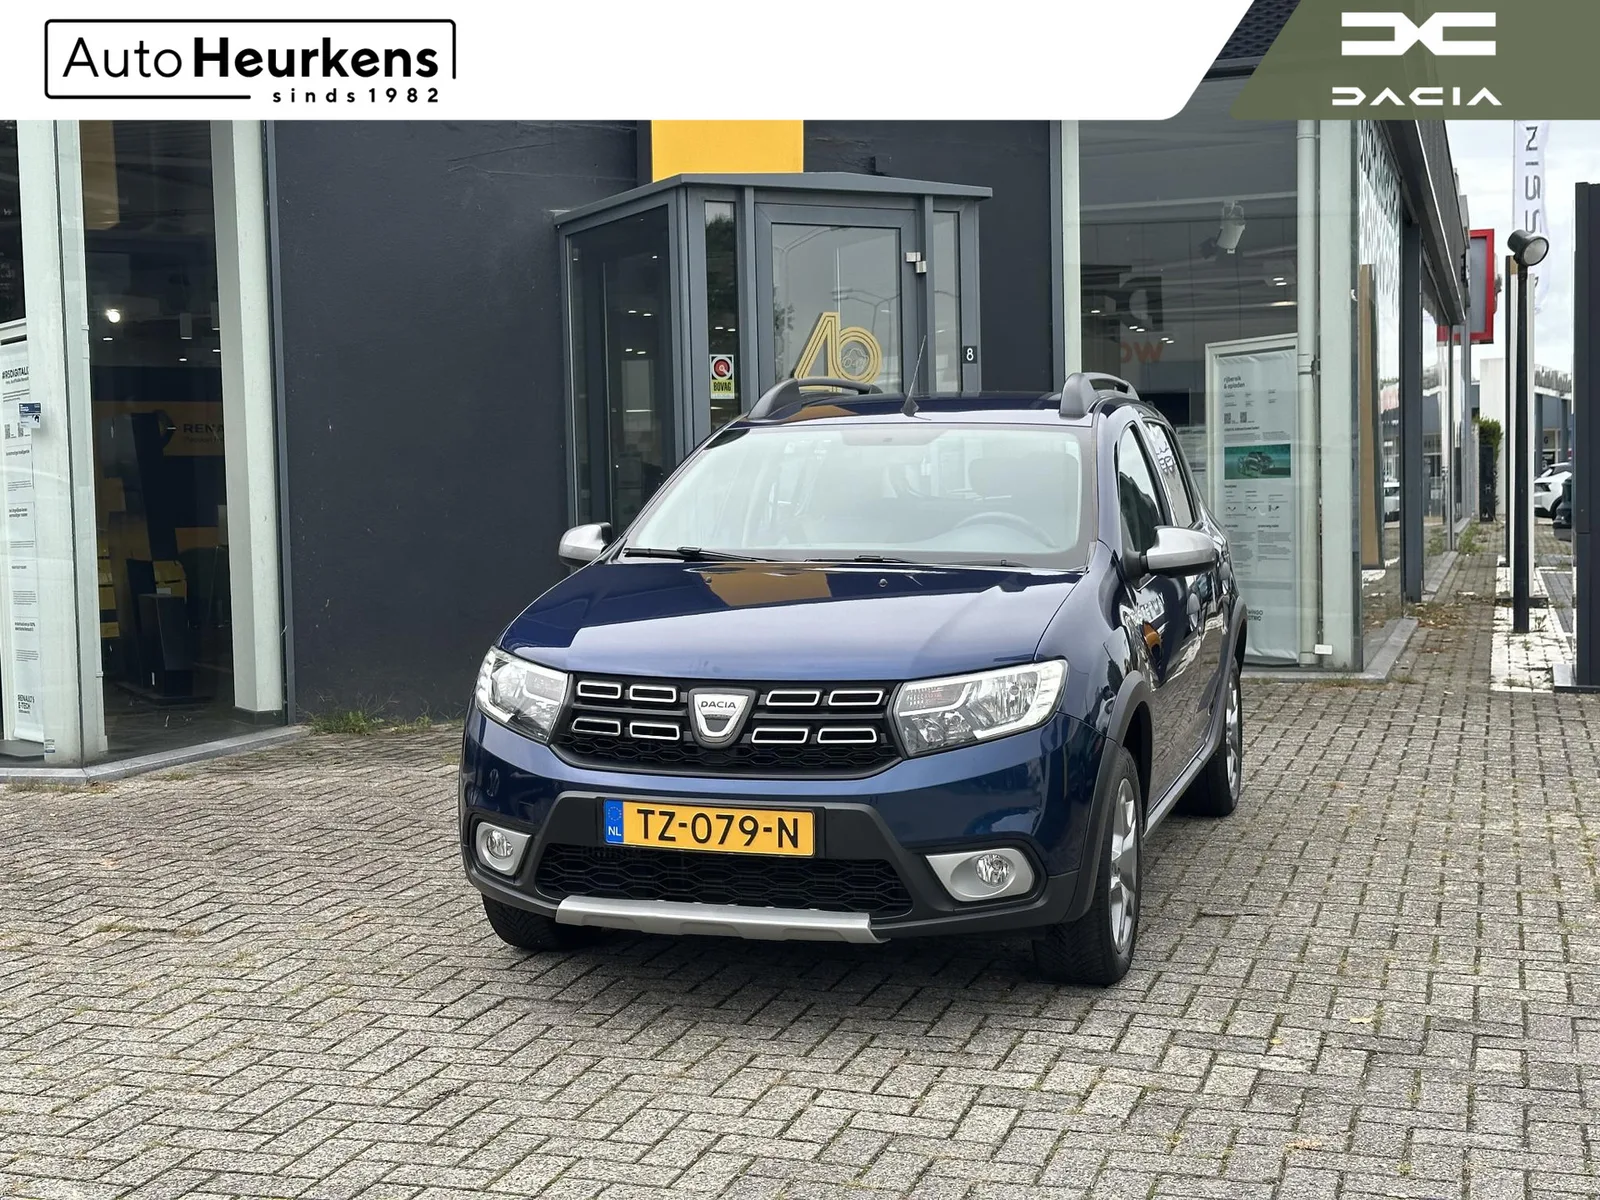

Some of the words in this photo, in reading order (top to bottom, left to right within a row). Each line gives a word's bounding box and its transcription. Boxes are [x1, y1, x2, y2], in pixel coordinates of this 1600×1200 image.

[966, 347, 974, 361] 8
[713, 381, 732, 391] BOVAG
[700, 700, 737, 709] DACIA
[607, 825, 622, 837] NL
[636, 808, 799, 849] TZ-079-N
